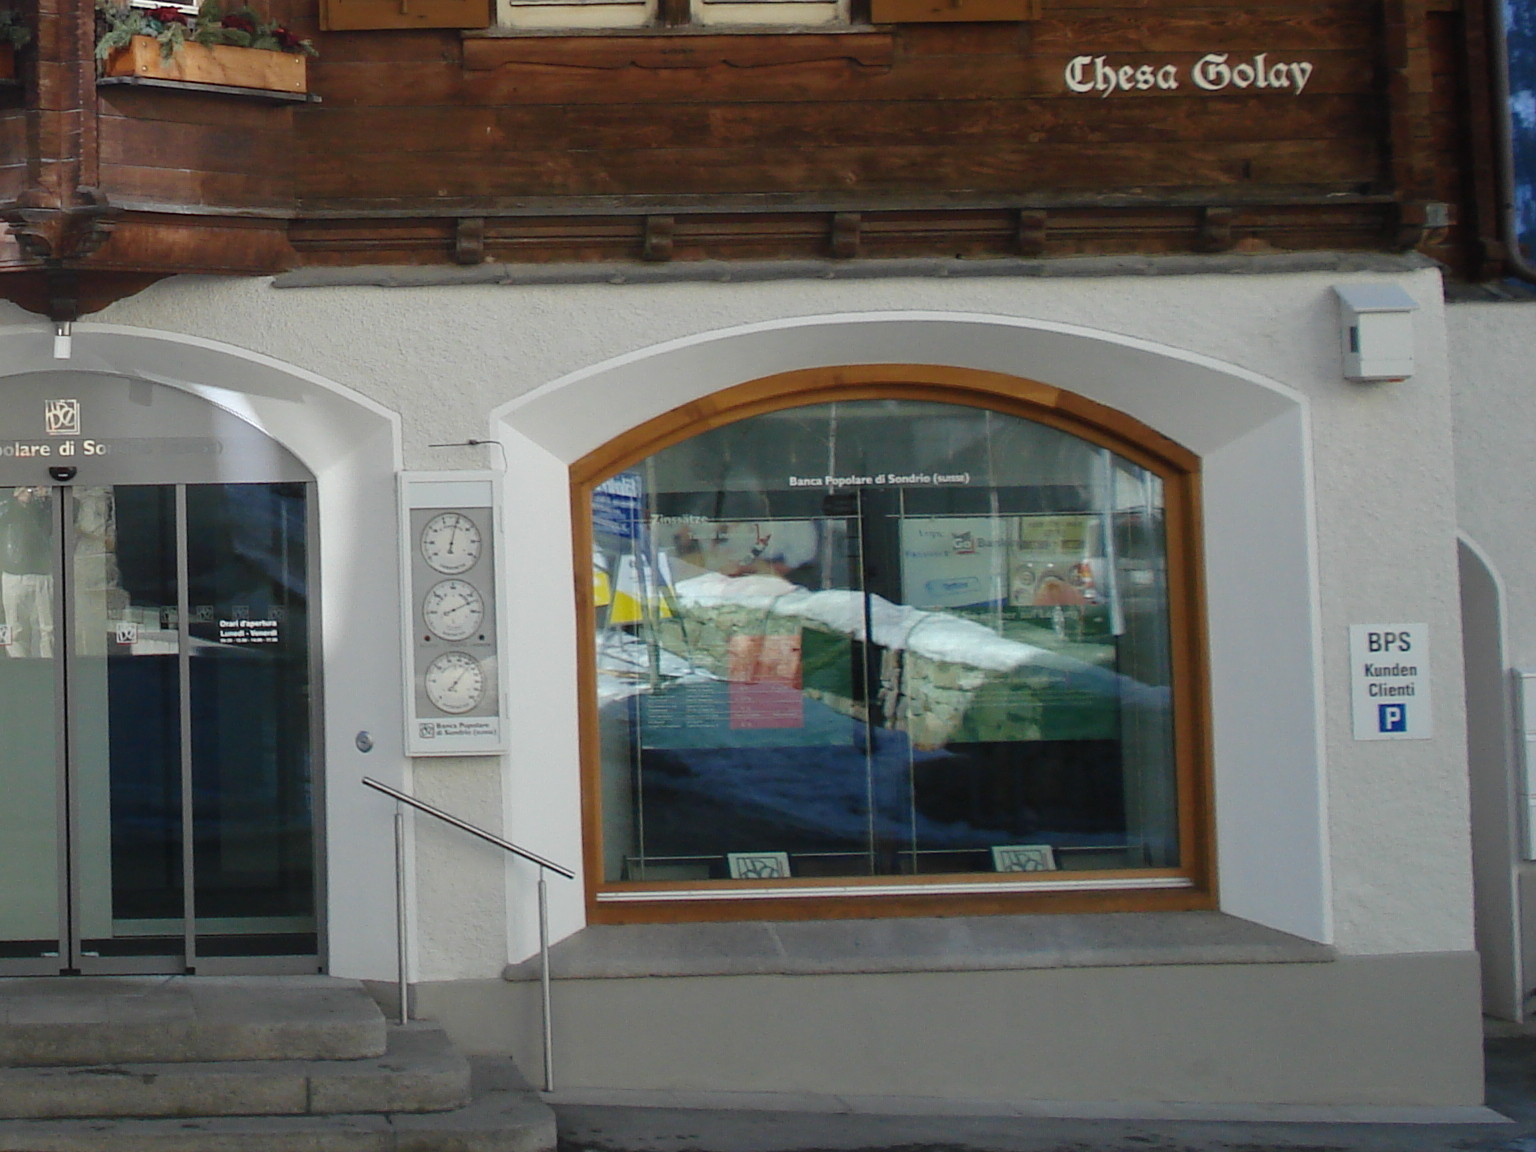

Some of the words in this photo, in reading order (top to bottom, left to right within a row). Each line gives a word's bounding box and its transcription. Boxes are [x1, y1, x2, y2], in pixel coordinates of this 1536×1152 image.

[1064, 54, 1140, 99] Chesa
[1190, 52, 1314, 96] Golay
[58, 440, 75, 457] di
[788, 475, 822, 487] Banca
[824, 474, 873, 489] Popolare
[874, 473, 886, 486] di
[887, 472, 931, 485] Sondrio
[1367, 631, 1412, 653] BPS
[1364, 663, 1418, 677] Kunden
[1368, 682, 1415, 697] Clienti
[1386, 707, 1402, 731] P
